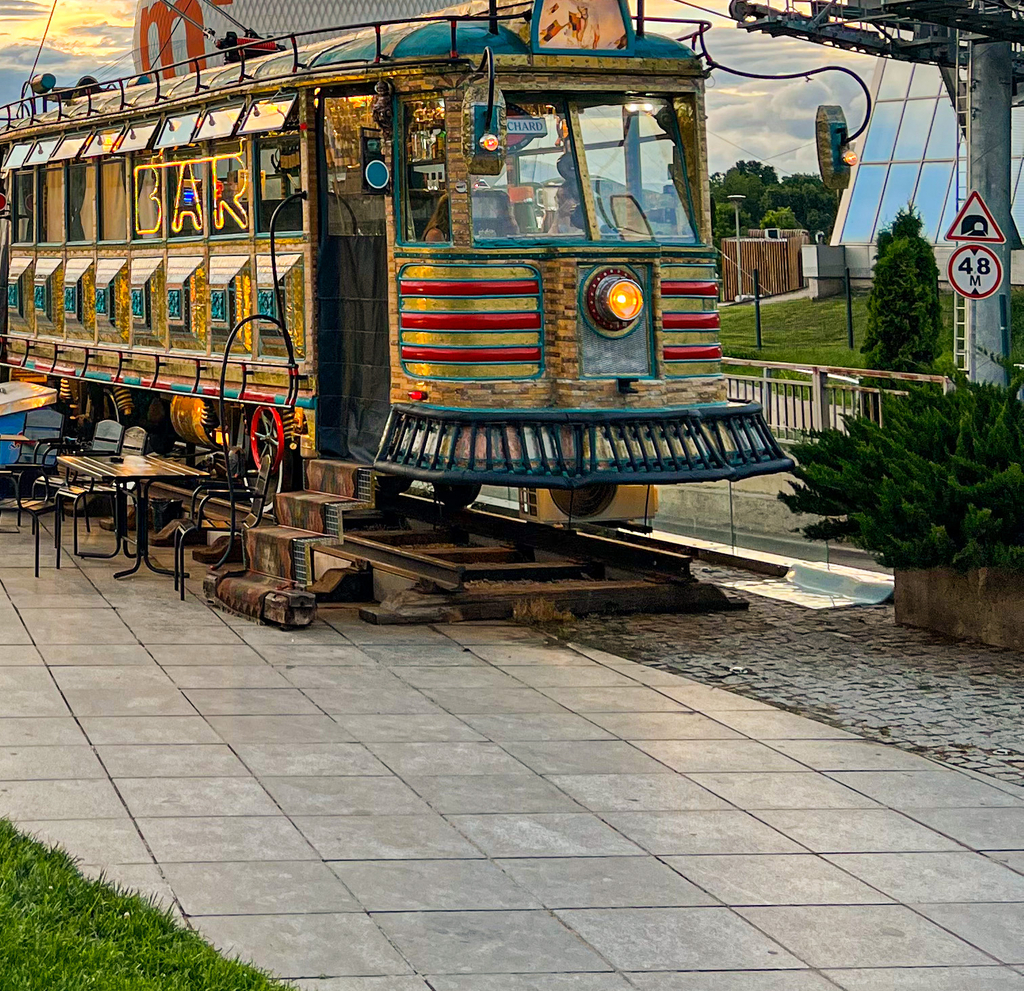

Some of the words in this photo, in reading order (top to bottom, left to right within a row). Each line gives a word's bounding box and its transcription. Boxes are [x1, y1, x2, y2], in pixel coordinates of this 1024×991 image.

[507, 121, 543, 132] CHARD
[134, 154, 249, 235] BAR
[969, 275, 981, 287] M
